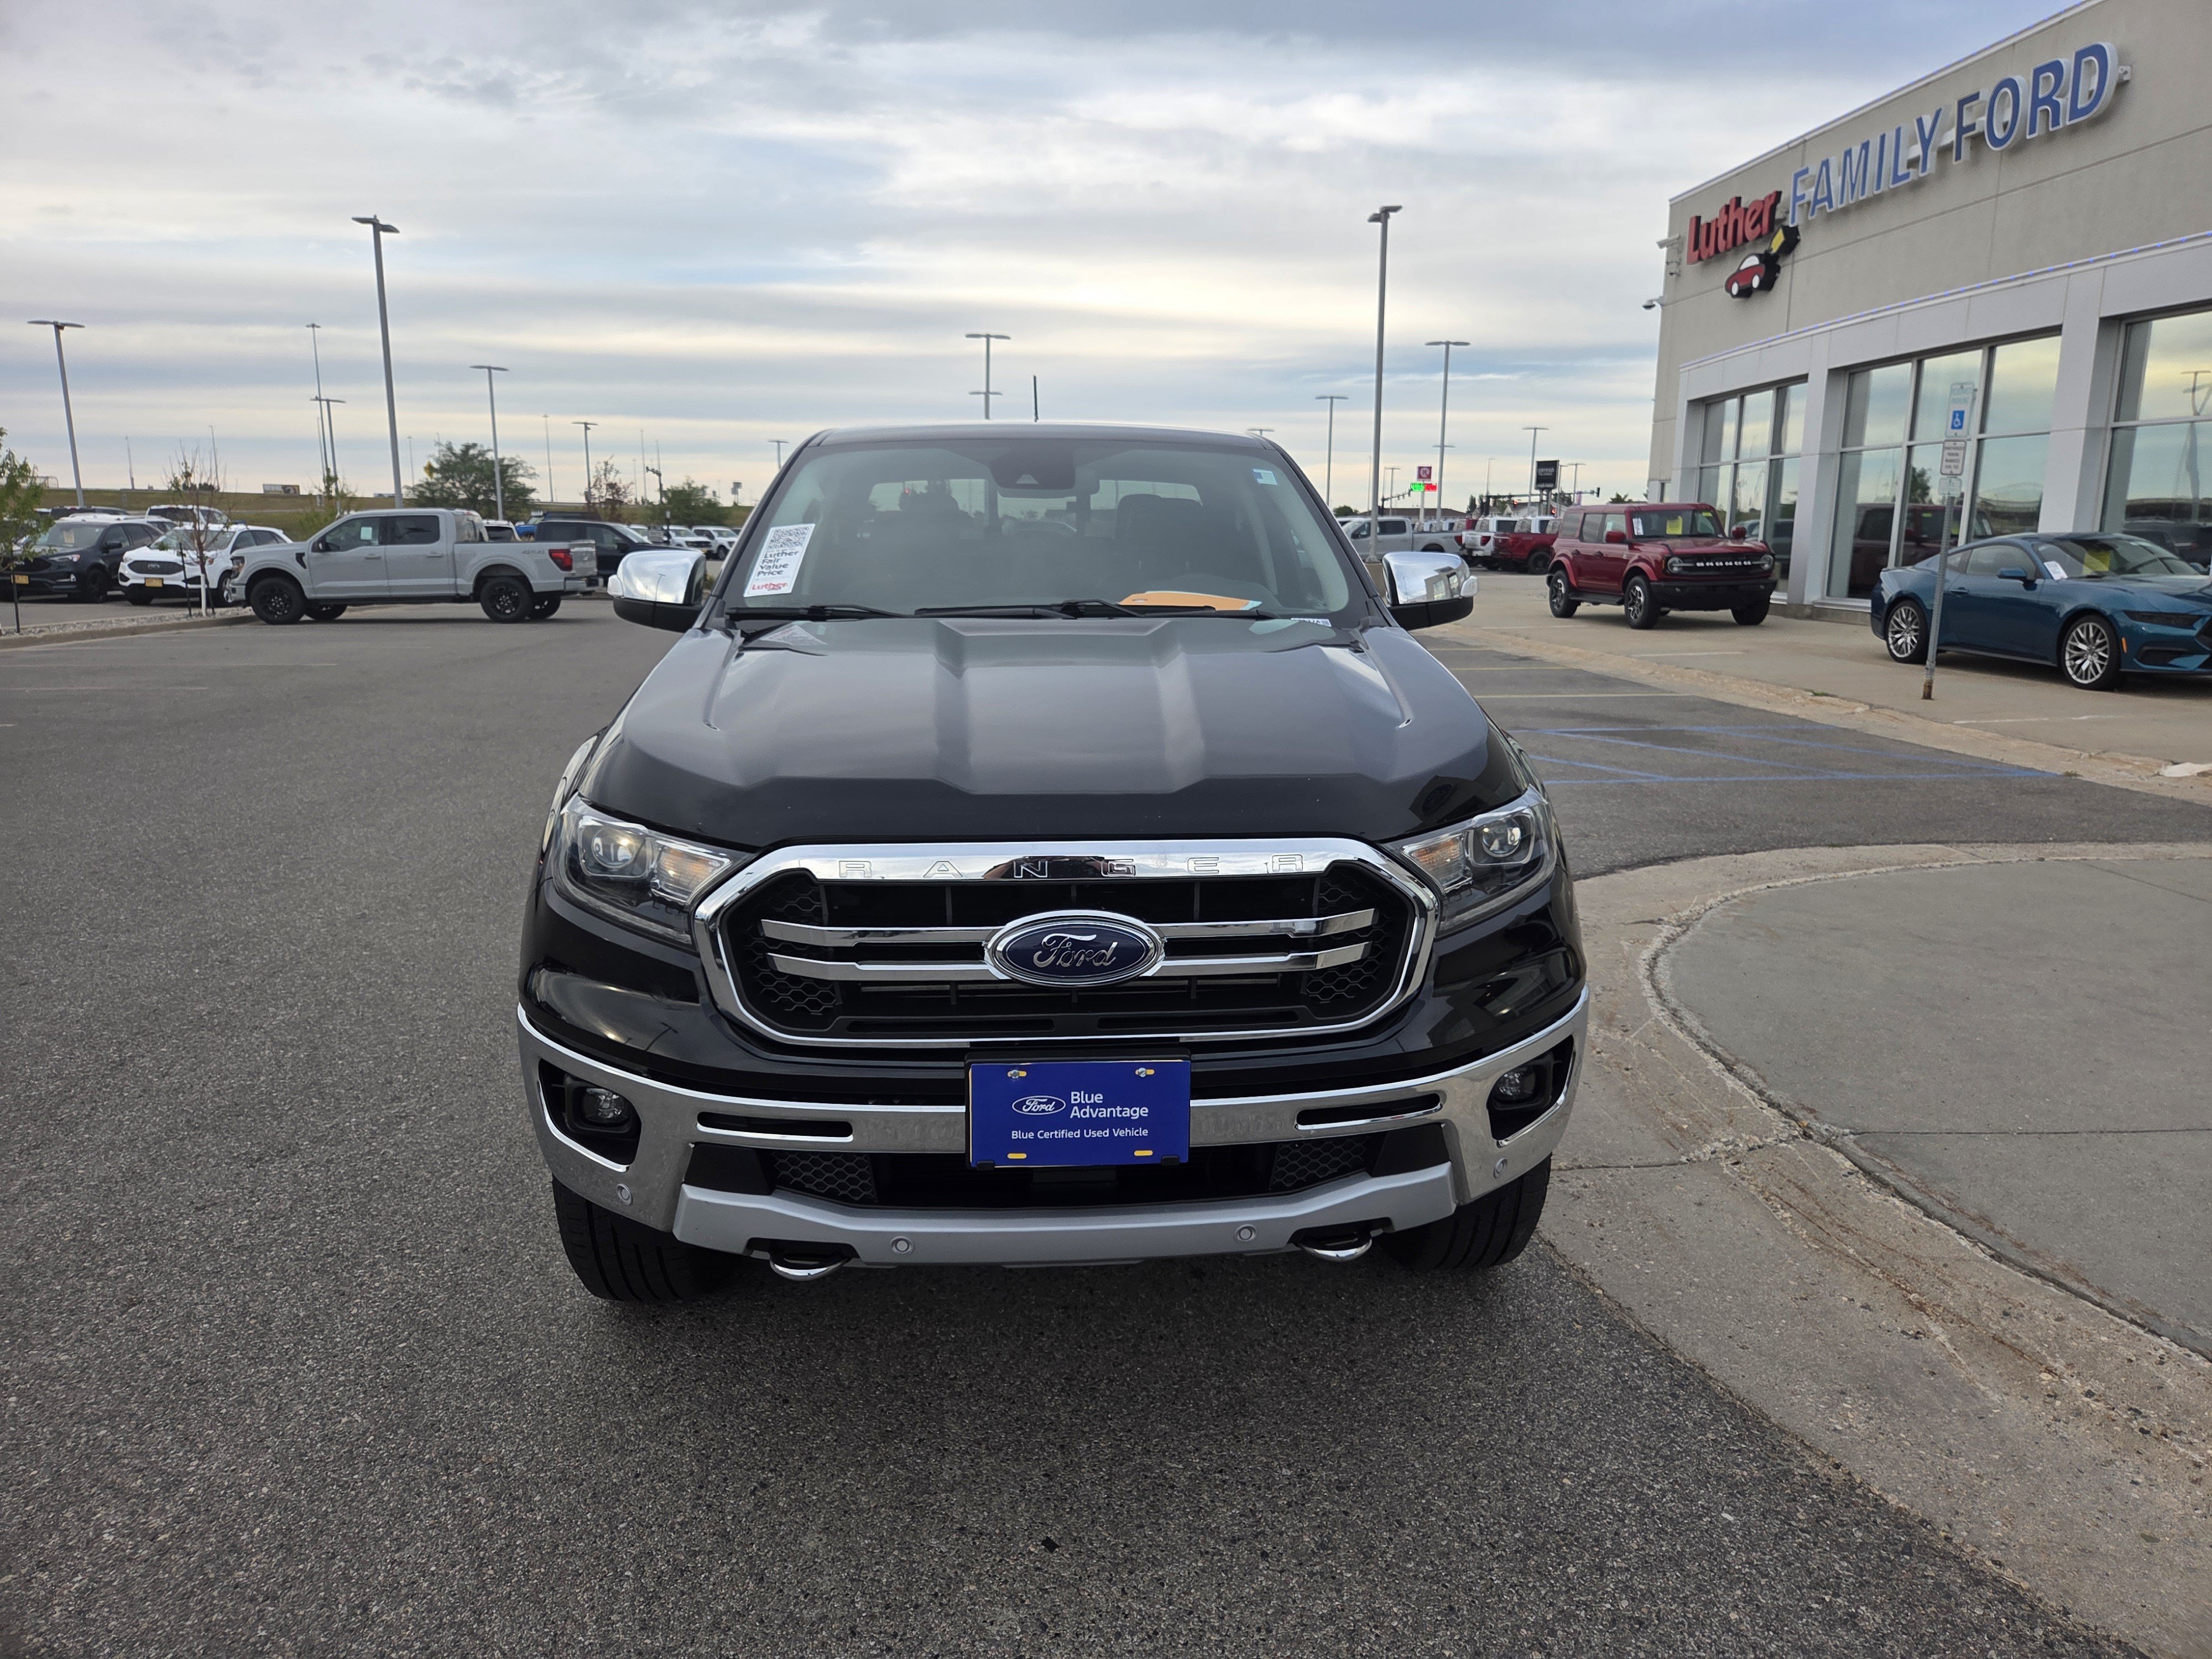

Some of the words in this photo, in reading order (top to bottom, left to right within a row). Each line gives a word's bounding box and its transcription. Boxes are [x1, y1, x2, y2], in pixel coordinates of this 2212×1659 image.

[1789, 107, 1944, 227] FAMILY
[1953, 41, 2117, 164] FORD
[1687, 190, 1782, 265] Luther
[752, 582, 787, 591] Luther
[838, 854, 1303, 878] RANGER
[1032, 933, 1118, 968] Ford
[1071, 1091, 1103, 1104] Blue
[1022, 1098, 1055, 1113] Ford
[1070, 1105, 1149, 1120] Advantage
[1011, 1130, 1034, 1139] Blue
[1037, 1129, 1081, 1139] Certified
[1083, 1129, 1109, 1138] Used
[1112, 1128, 1149, 1137] Vehicle
